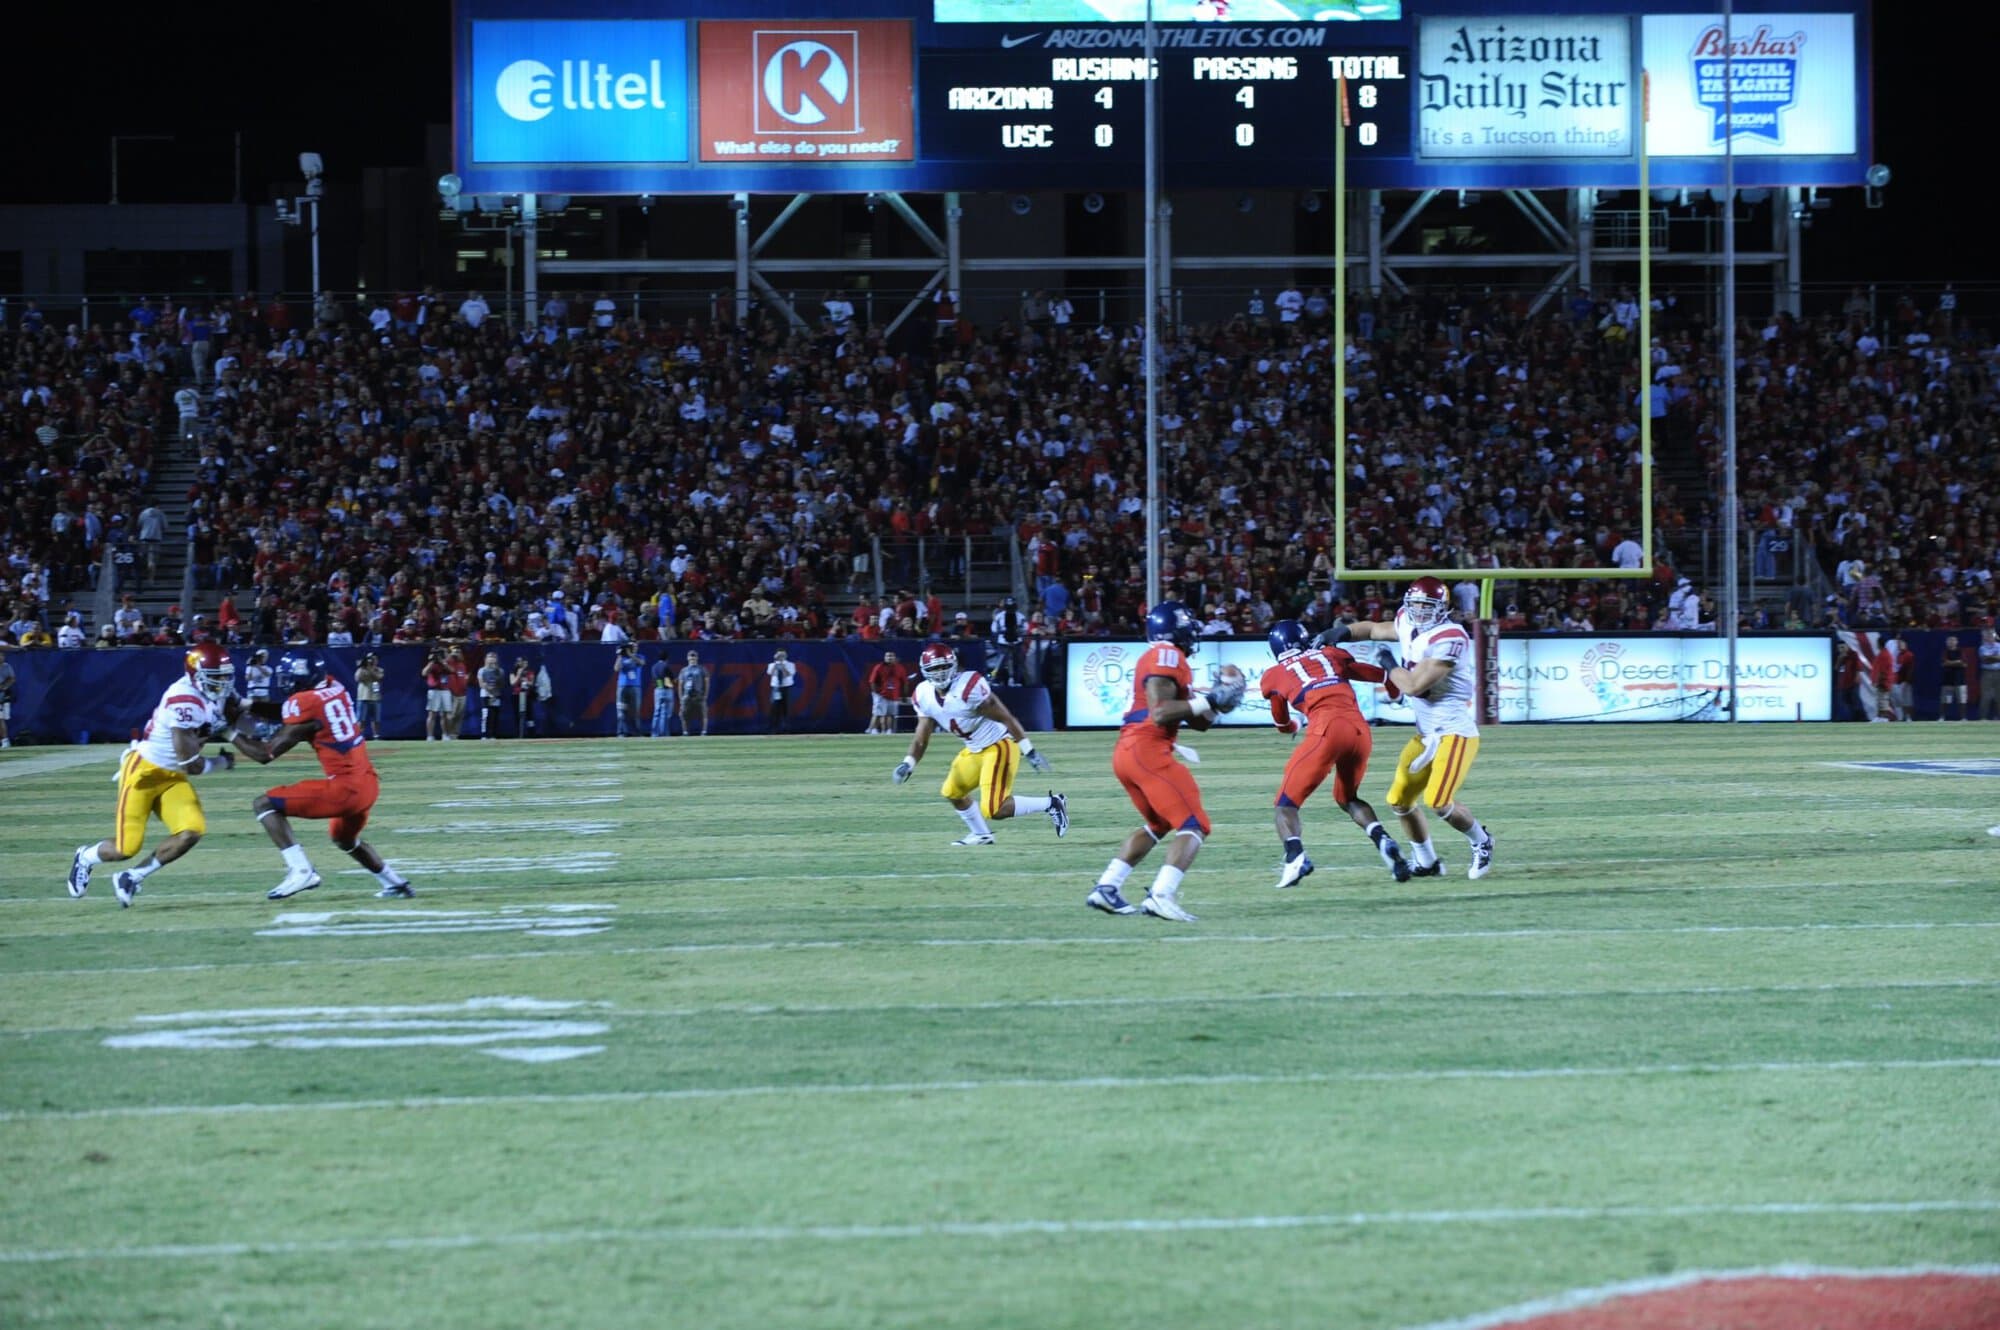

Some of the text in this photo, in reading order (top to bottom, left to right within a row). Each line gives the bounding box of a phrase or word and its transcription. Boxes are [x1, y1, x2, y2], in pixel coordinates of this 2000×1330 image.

[1443, 25, 1603, 65] Arizona
[1052, 56, 1405, 81] RUSHING PASSING TOTAL
[527, 58, 666, 111] alltel
[1419, 70, 1627, 118] Daily Star
[1700, 78, 1791, 92] TALGATE
[948, 86, 1377, 110] ARIZONA 4 4 8
[1002, 123, 1377, 148] USC 0 0 0
[1422, 127, 1453, 145] It's
[1461, 131, 1473, 144] a
[1481, 127, 1557, 145] Tucson
[713, 140, 899, 157] What else do you need?
[1768, 540, 1789, 552] 29
[114, 552, 135, 564] 26
[1156, 648, 1180, 668] 10
[1284, 653, 1339, 688] 11
[1498, 665, 1569, 681] MOND
